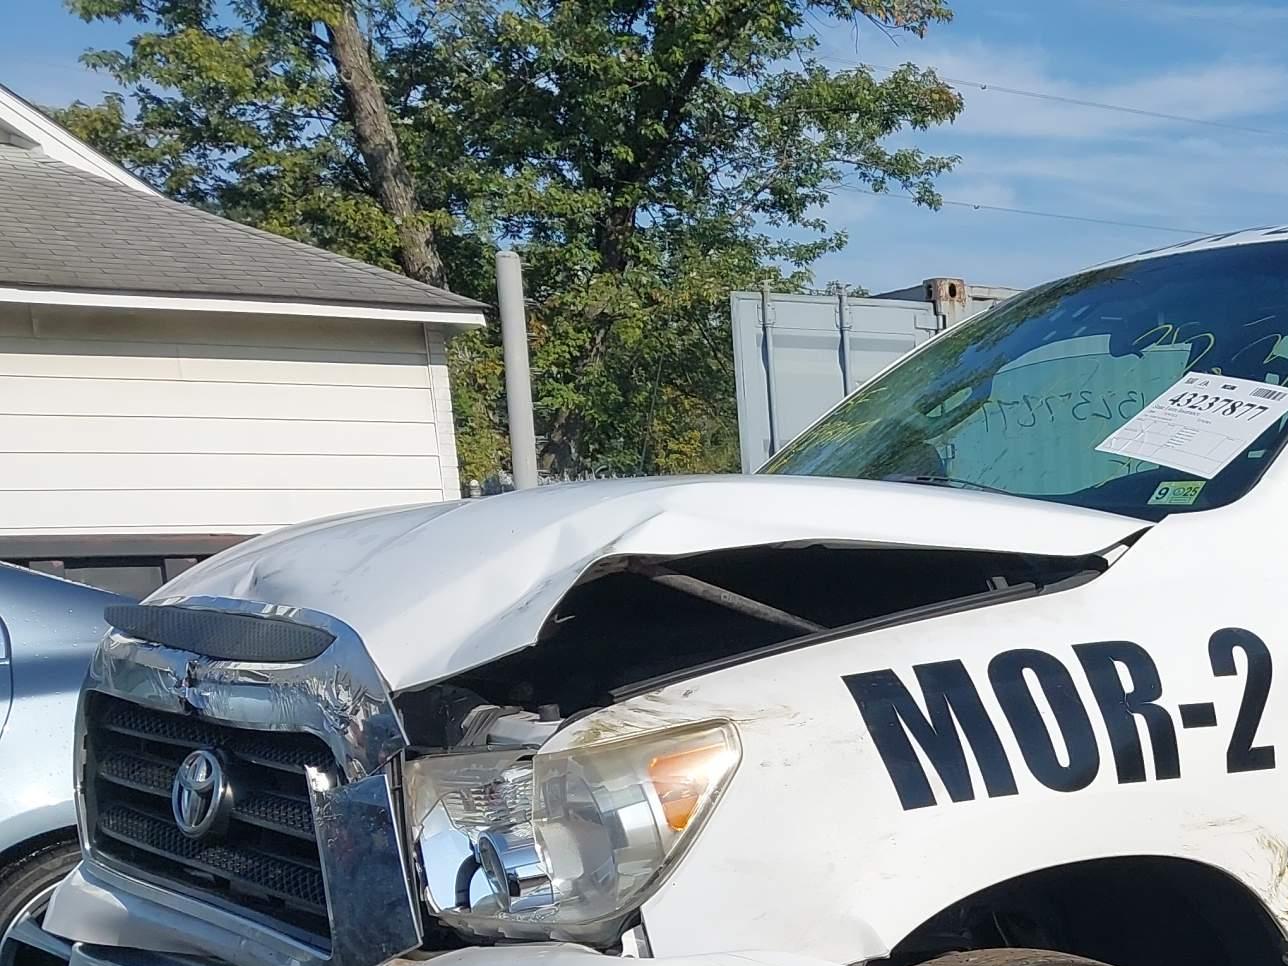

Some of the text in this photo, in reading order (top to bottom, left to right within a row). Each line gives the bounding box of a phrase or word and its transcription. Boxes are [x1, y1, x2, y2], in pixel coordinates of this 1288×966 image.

[1168, 391, 1269, 421] 43237877
[1155, 487, 1169, 500] 9
[840, 627, 1276, 810] MOR-2
